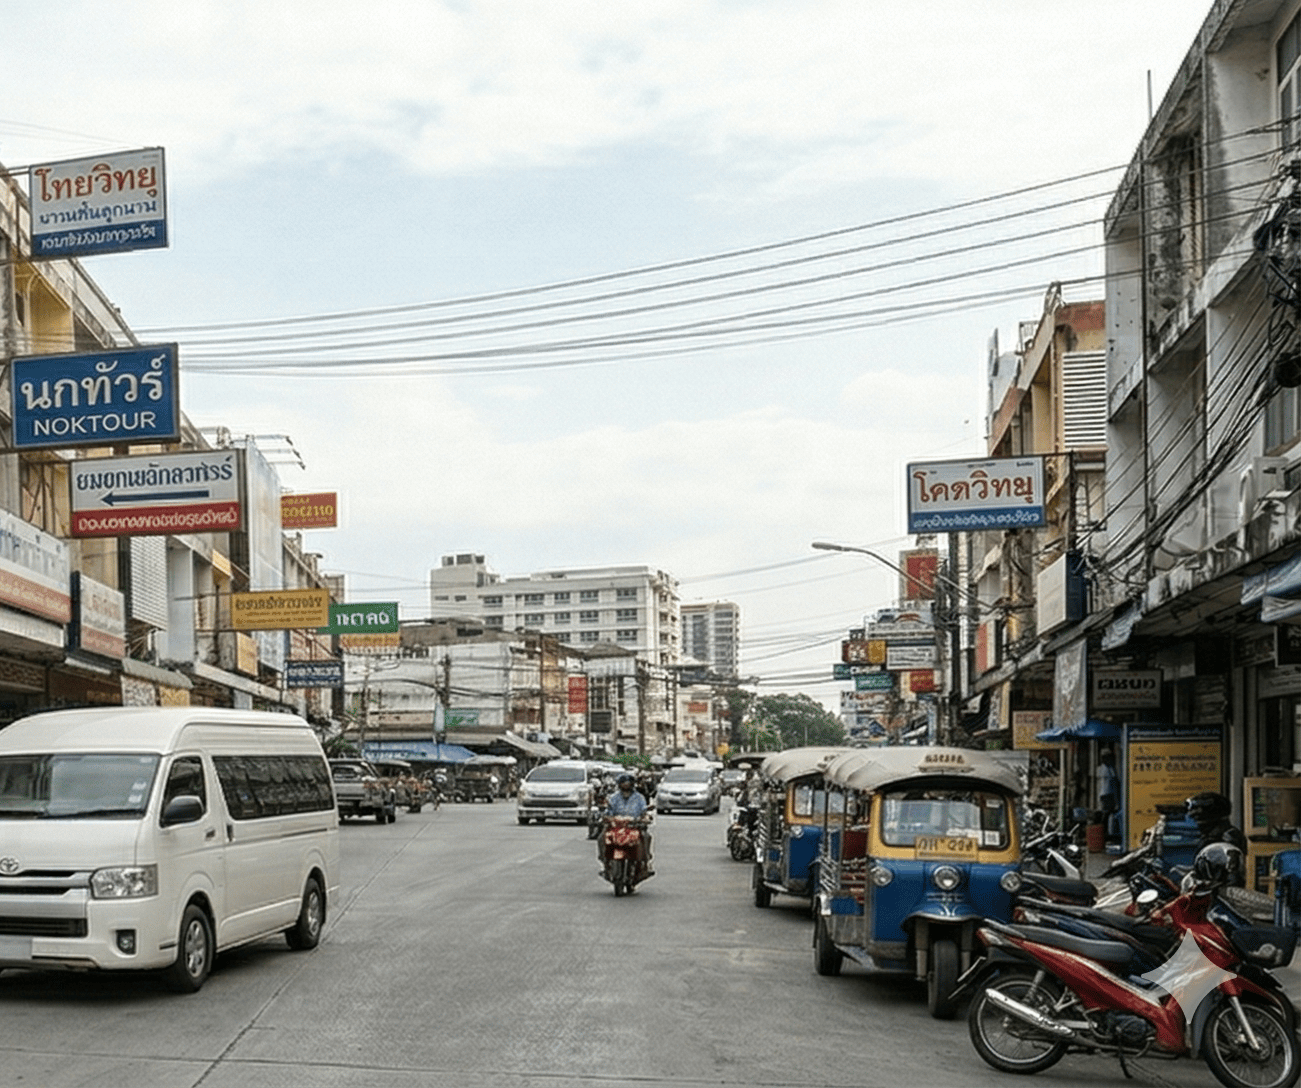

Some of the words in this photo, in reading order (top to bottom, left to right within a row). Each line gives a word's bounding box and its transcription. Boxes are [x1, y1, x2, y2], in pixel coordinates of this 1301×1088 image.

[21, 353, 166, 411] นกทัวร์
[34, 411, 156, 437] NOKTOUR
